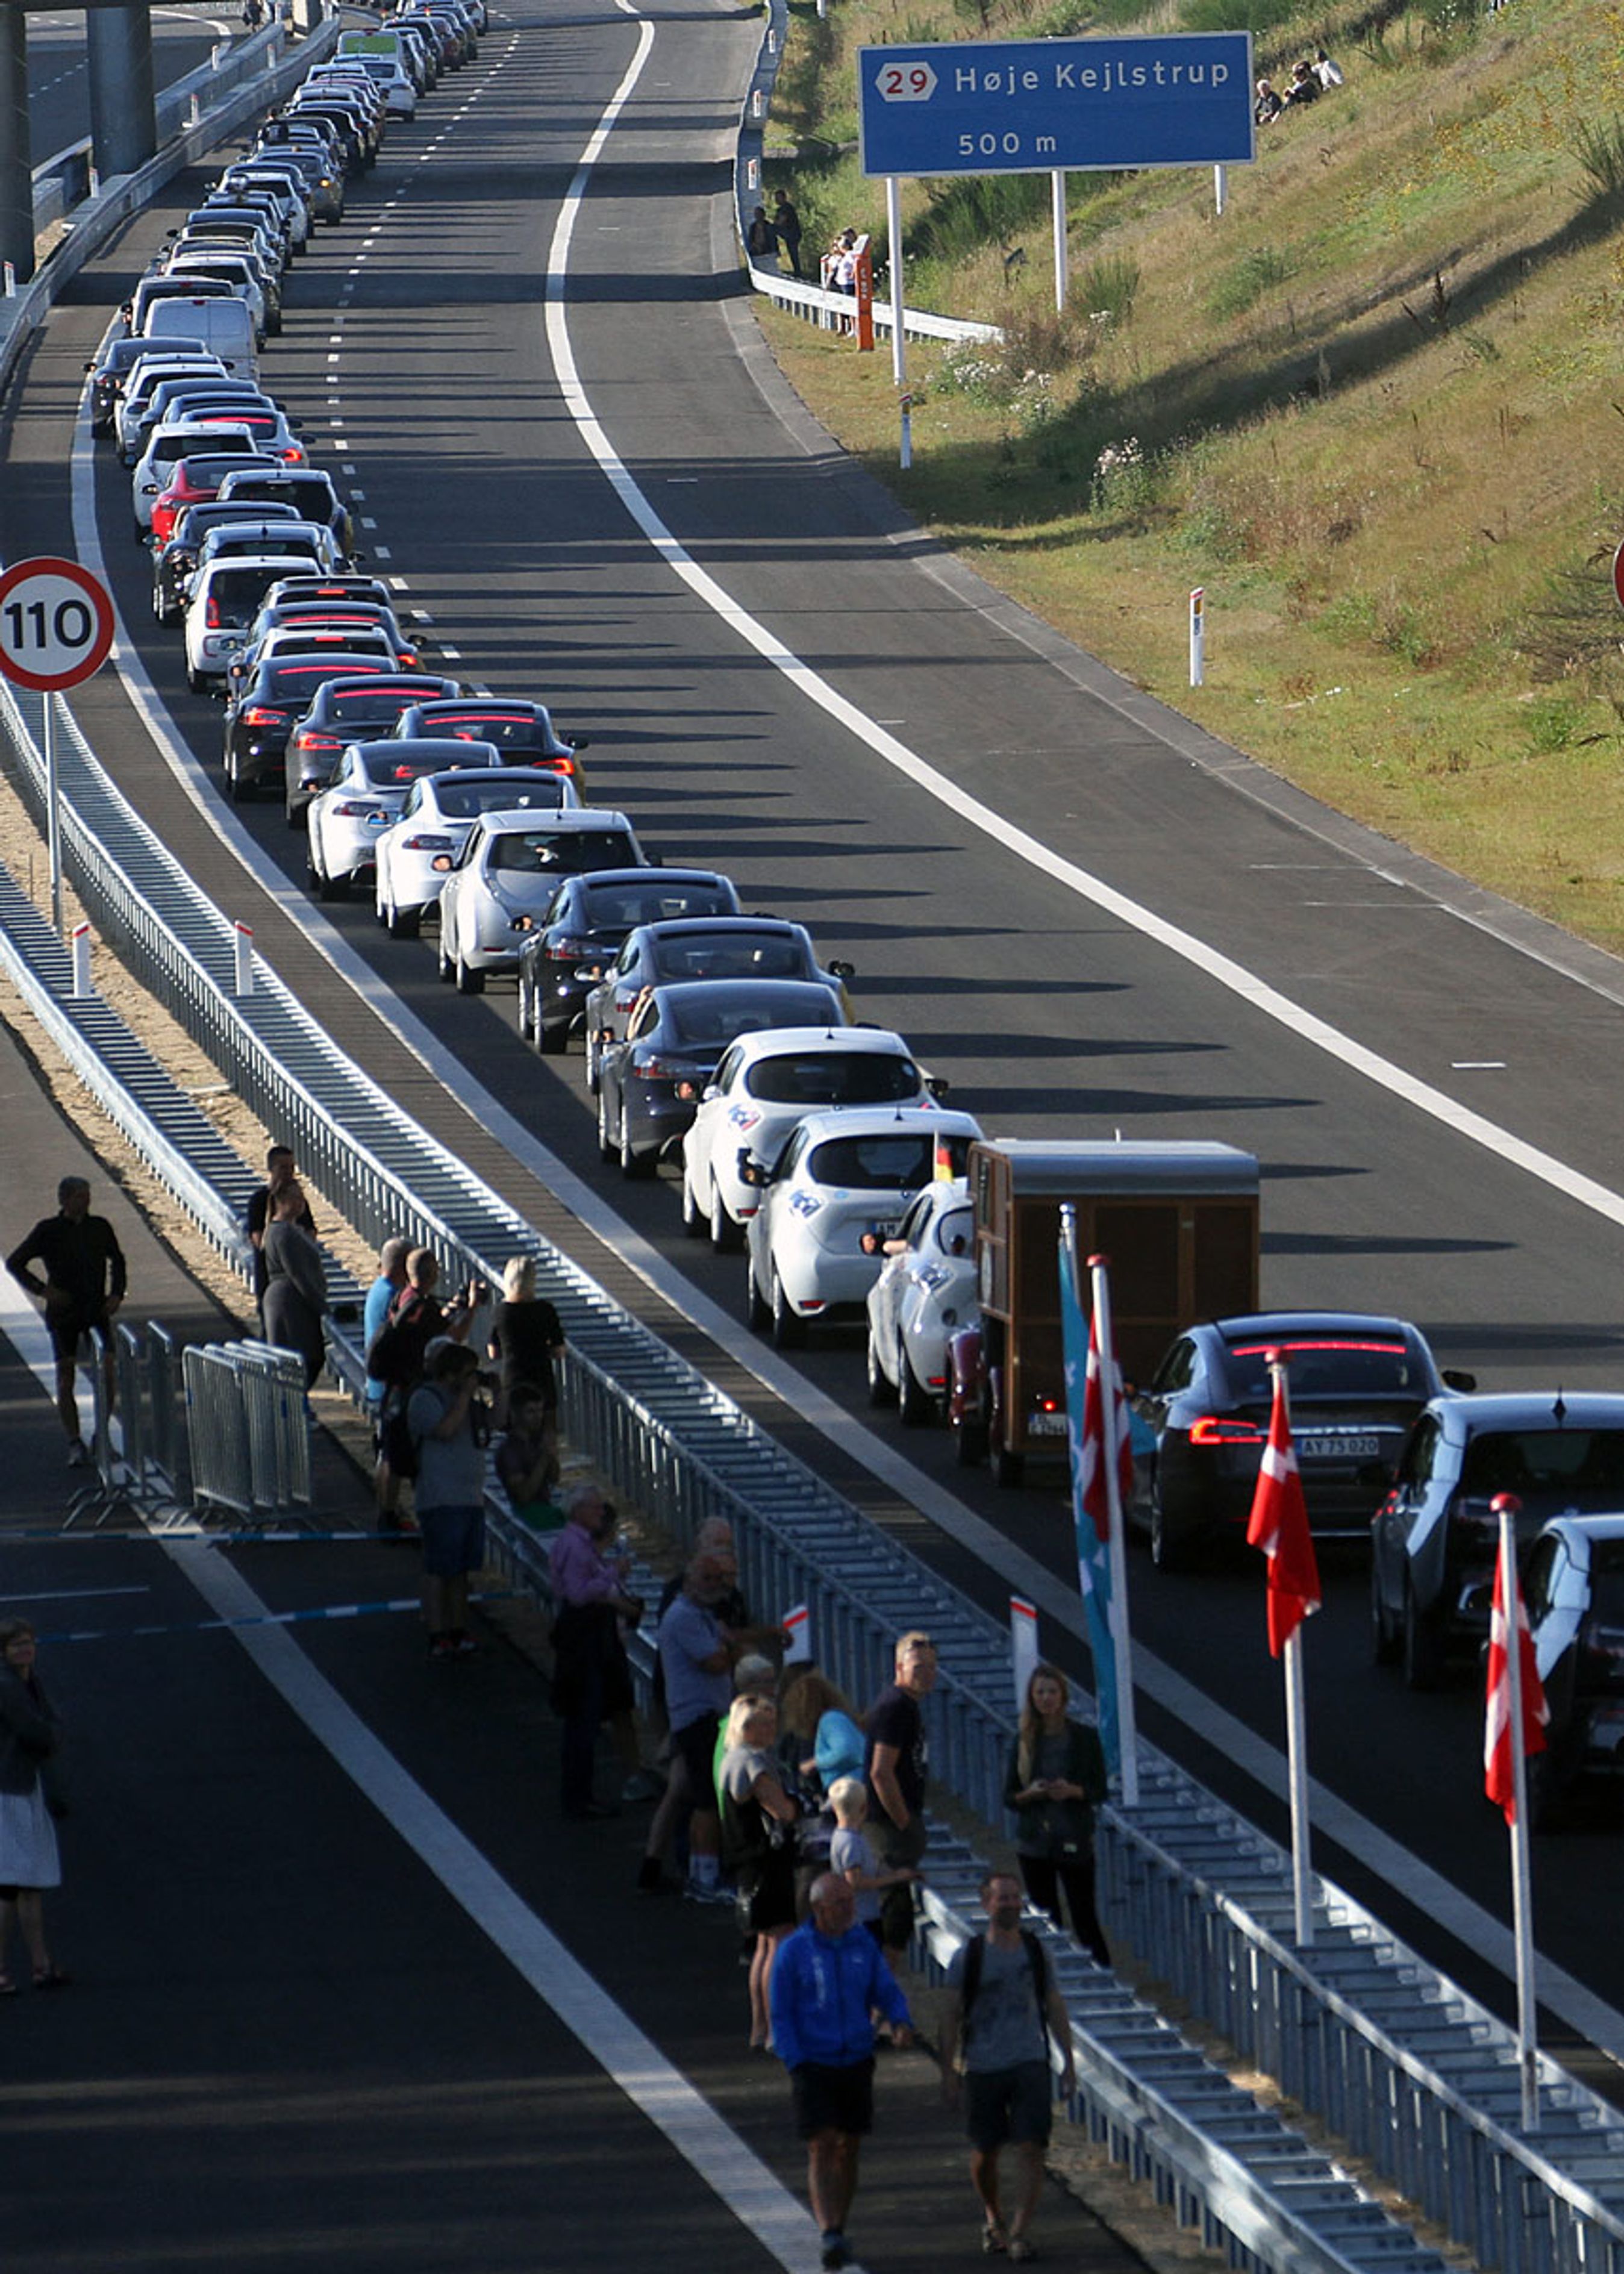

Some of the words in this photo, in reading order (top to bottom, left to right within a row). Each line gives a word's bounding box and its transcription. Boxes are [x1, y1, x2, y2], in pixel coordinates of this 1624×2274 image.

[886, 70, 927, 93] 29
[955, 66, 1039, 95] Høje
[1056, 61, 1229, 92] Kejlstrup
[959, 133, 1019, 155] 500
[1036, 136, 1056, 152] m
[4, 599, 92, 648] 110
